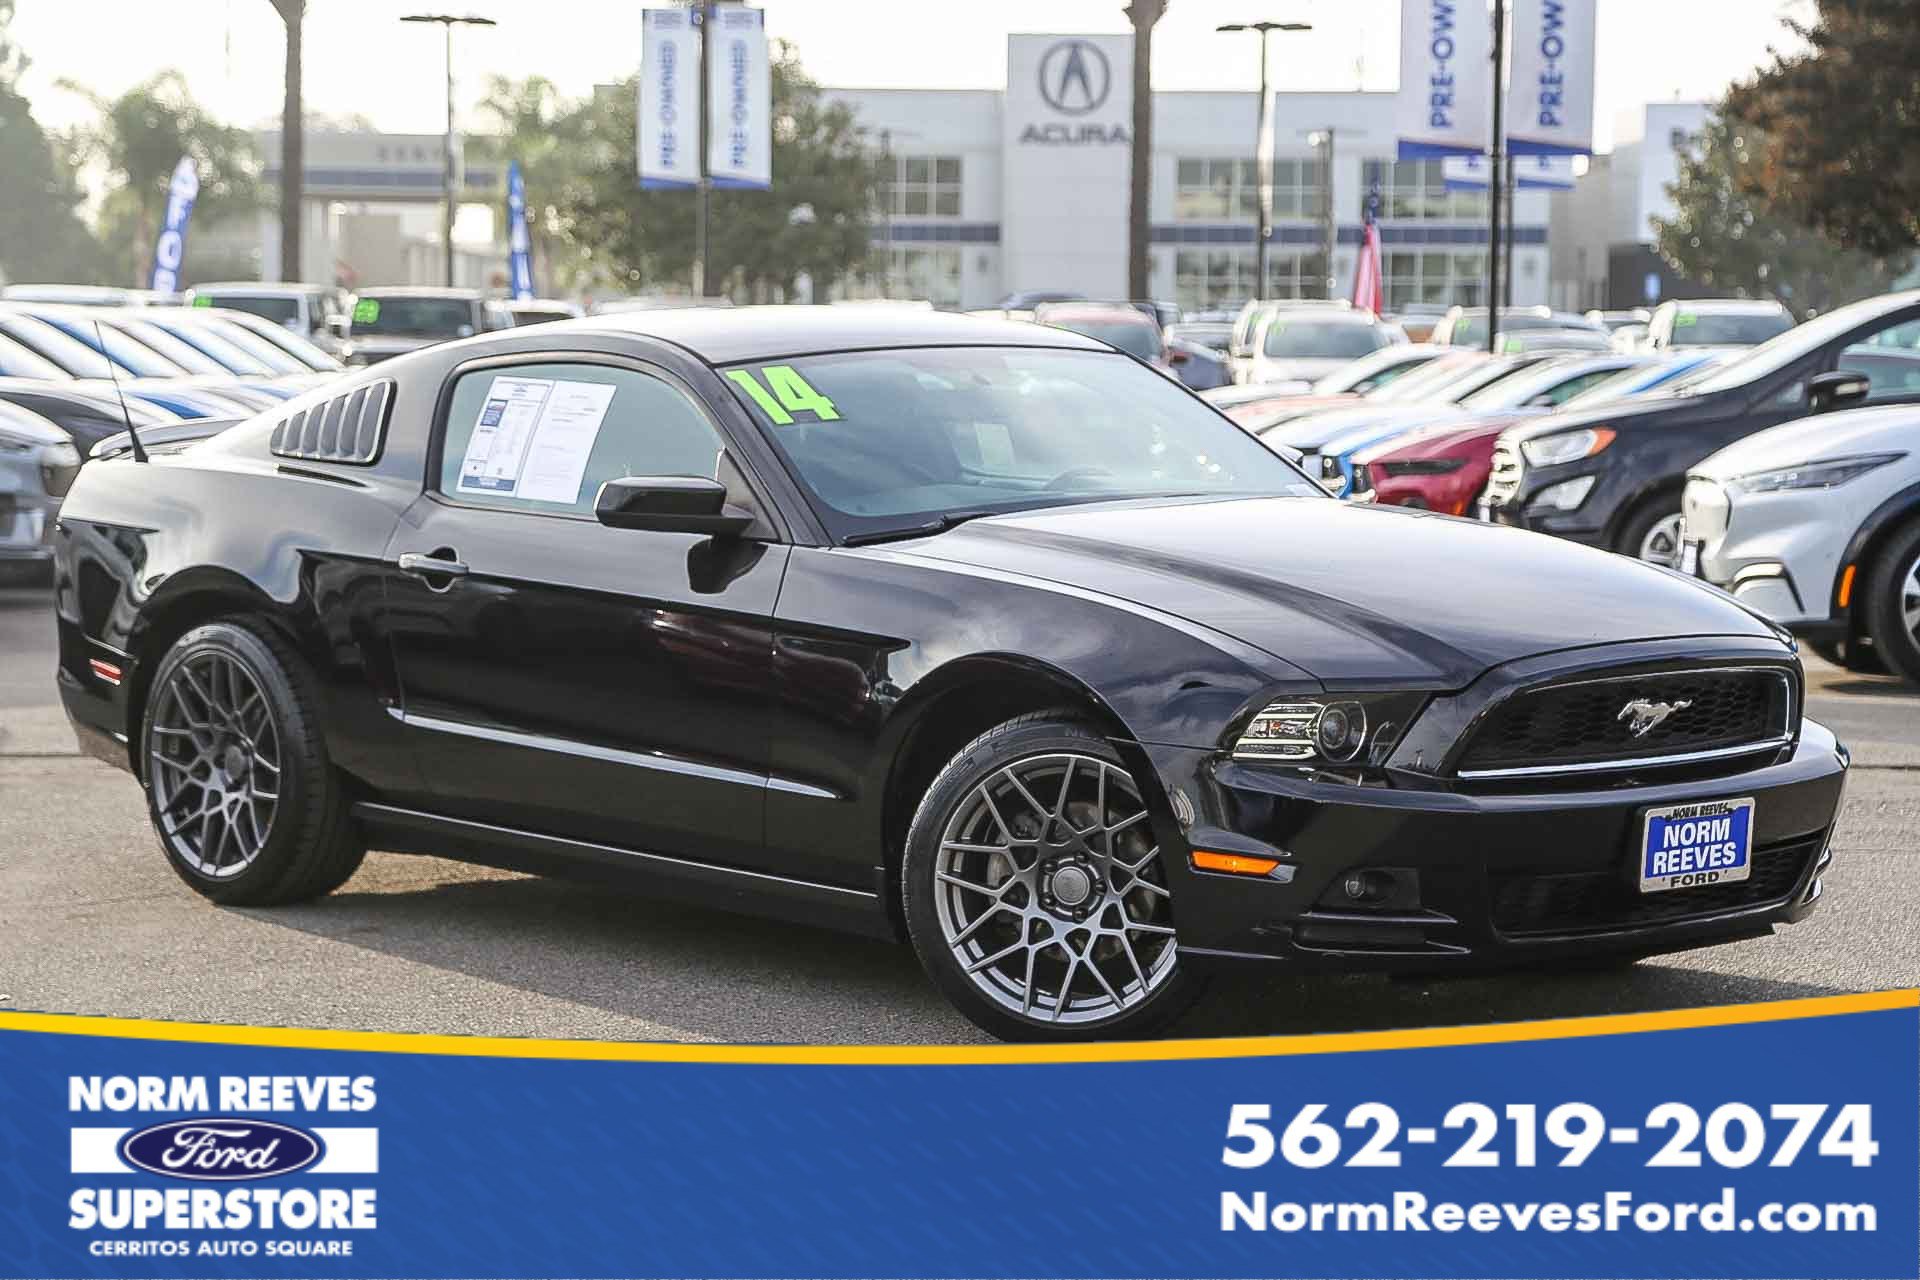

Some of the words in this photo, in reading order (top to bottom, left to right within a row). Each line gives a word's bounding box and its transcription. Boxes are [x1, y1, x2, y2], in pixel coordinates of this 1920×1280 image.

[1020, 122, 1133, 145] ACURA
[725, 365, 840, 425] 14
[1672, 806, 1698, 819] NORM
[1700, 803, 1728, 816] REEVES
[1664, 818, 1731, 848] NORM
[1653, 842, 1736, 875] REEVES
[1670, 871, 1720, 888] FORD
